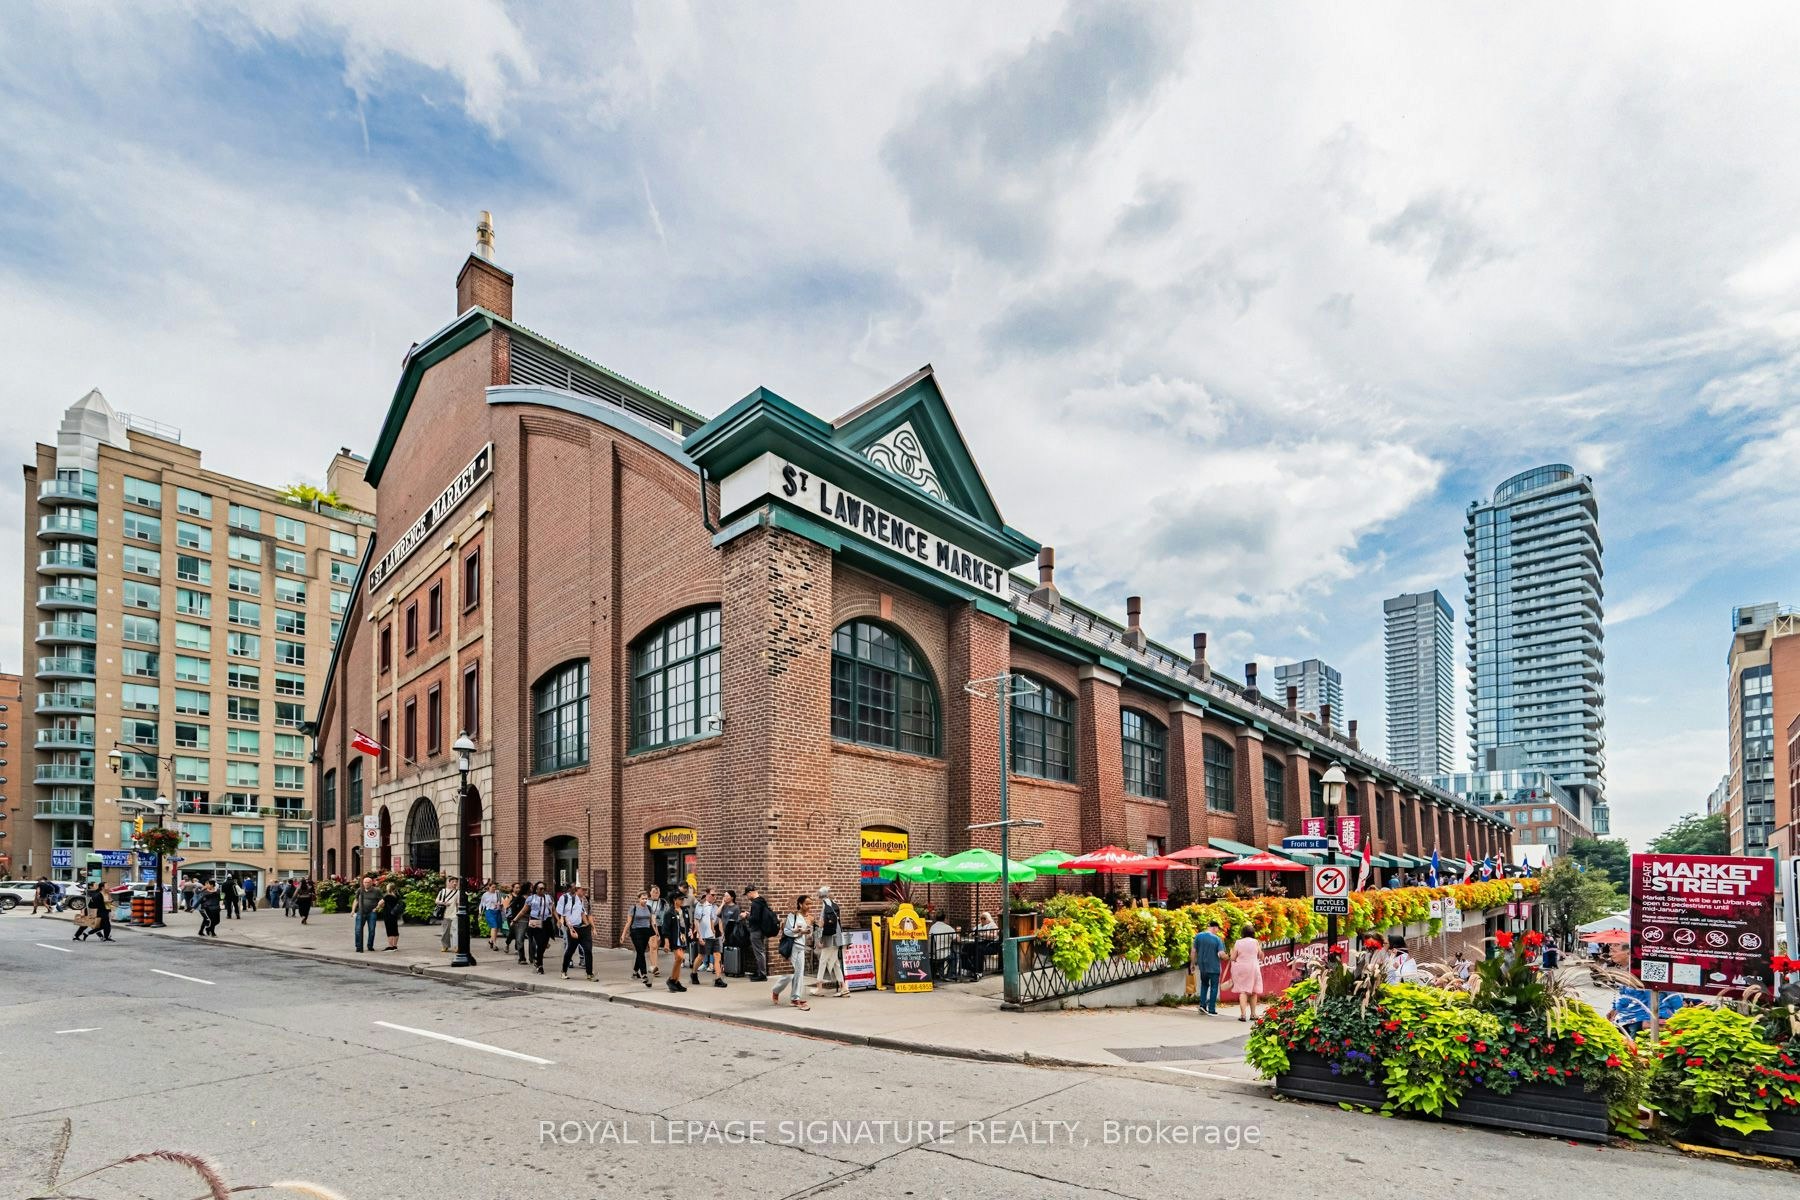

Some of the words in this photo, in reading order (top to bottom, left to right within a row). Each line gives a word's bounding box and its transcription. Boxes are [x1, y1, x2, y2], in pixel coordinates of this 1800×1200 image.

[385, 515, 427, 572] LAWRENCE
[431, 461, 476, 525] MARKET
[820, 482, 929, 561] LAWRENCE
[937, 540, 1004, 594] MARKET
[657, 831, 694, 846] Paddington's
[861, 838, 907, 853] Paddington's
[52, 849, 72, 857] BLUE
[52, 857, 72, 866] VAPE
[1643, 861, 1652, 887] HEART
[1652, 861, 1764, 881] MARKET
[1651, 876, 1752, 896] STREET
[1642, 906, 1688, 914] mid-January.
[1671, 902, 1713, 910] pedestrians
[902, 960, 920, 969] PATIO
